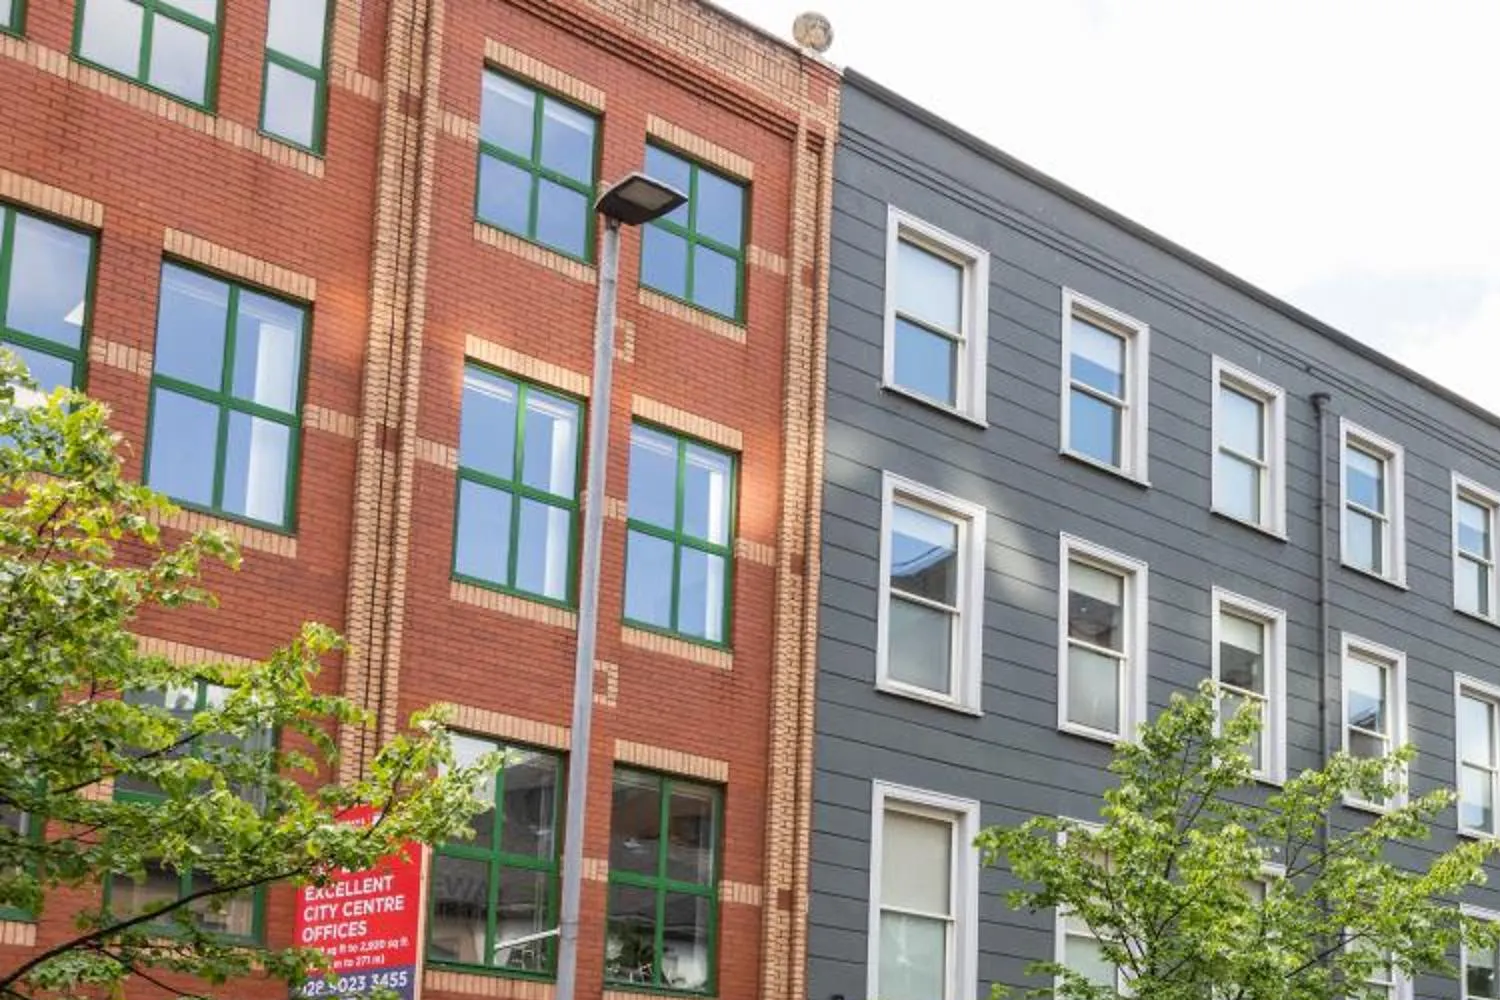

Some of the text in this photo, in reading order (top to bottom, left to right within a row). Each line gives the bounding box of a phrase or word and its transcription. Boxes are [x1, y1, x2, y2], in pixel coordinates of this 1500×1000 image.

[305, 875, 394, 901] EXCELLENT
[303, 895, 405, 922] CITY CENTRE
[302, 921, 367, 943] OFFICES
[328, 975, 367, 993] 023
